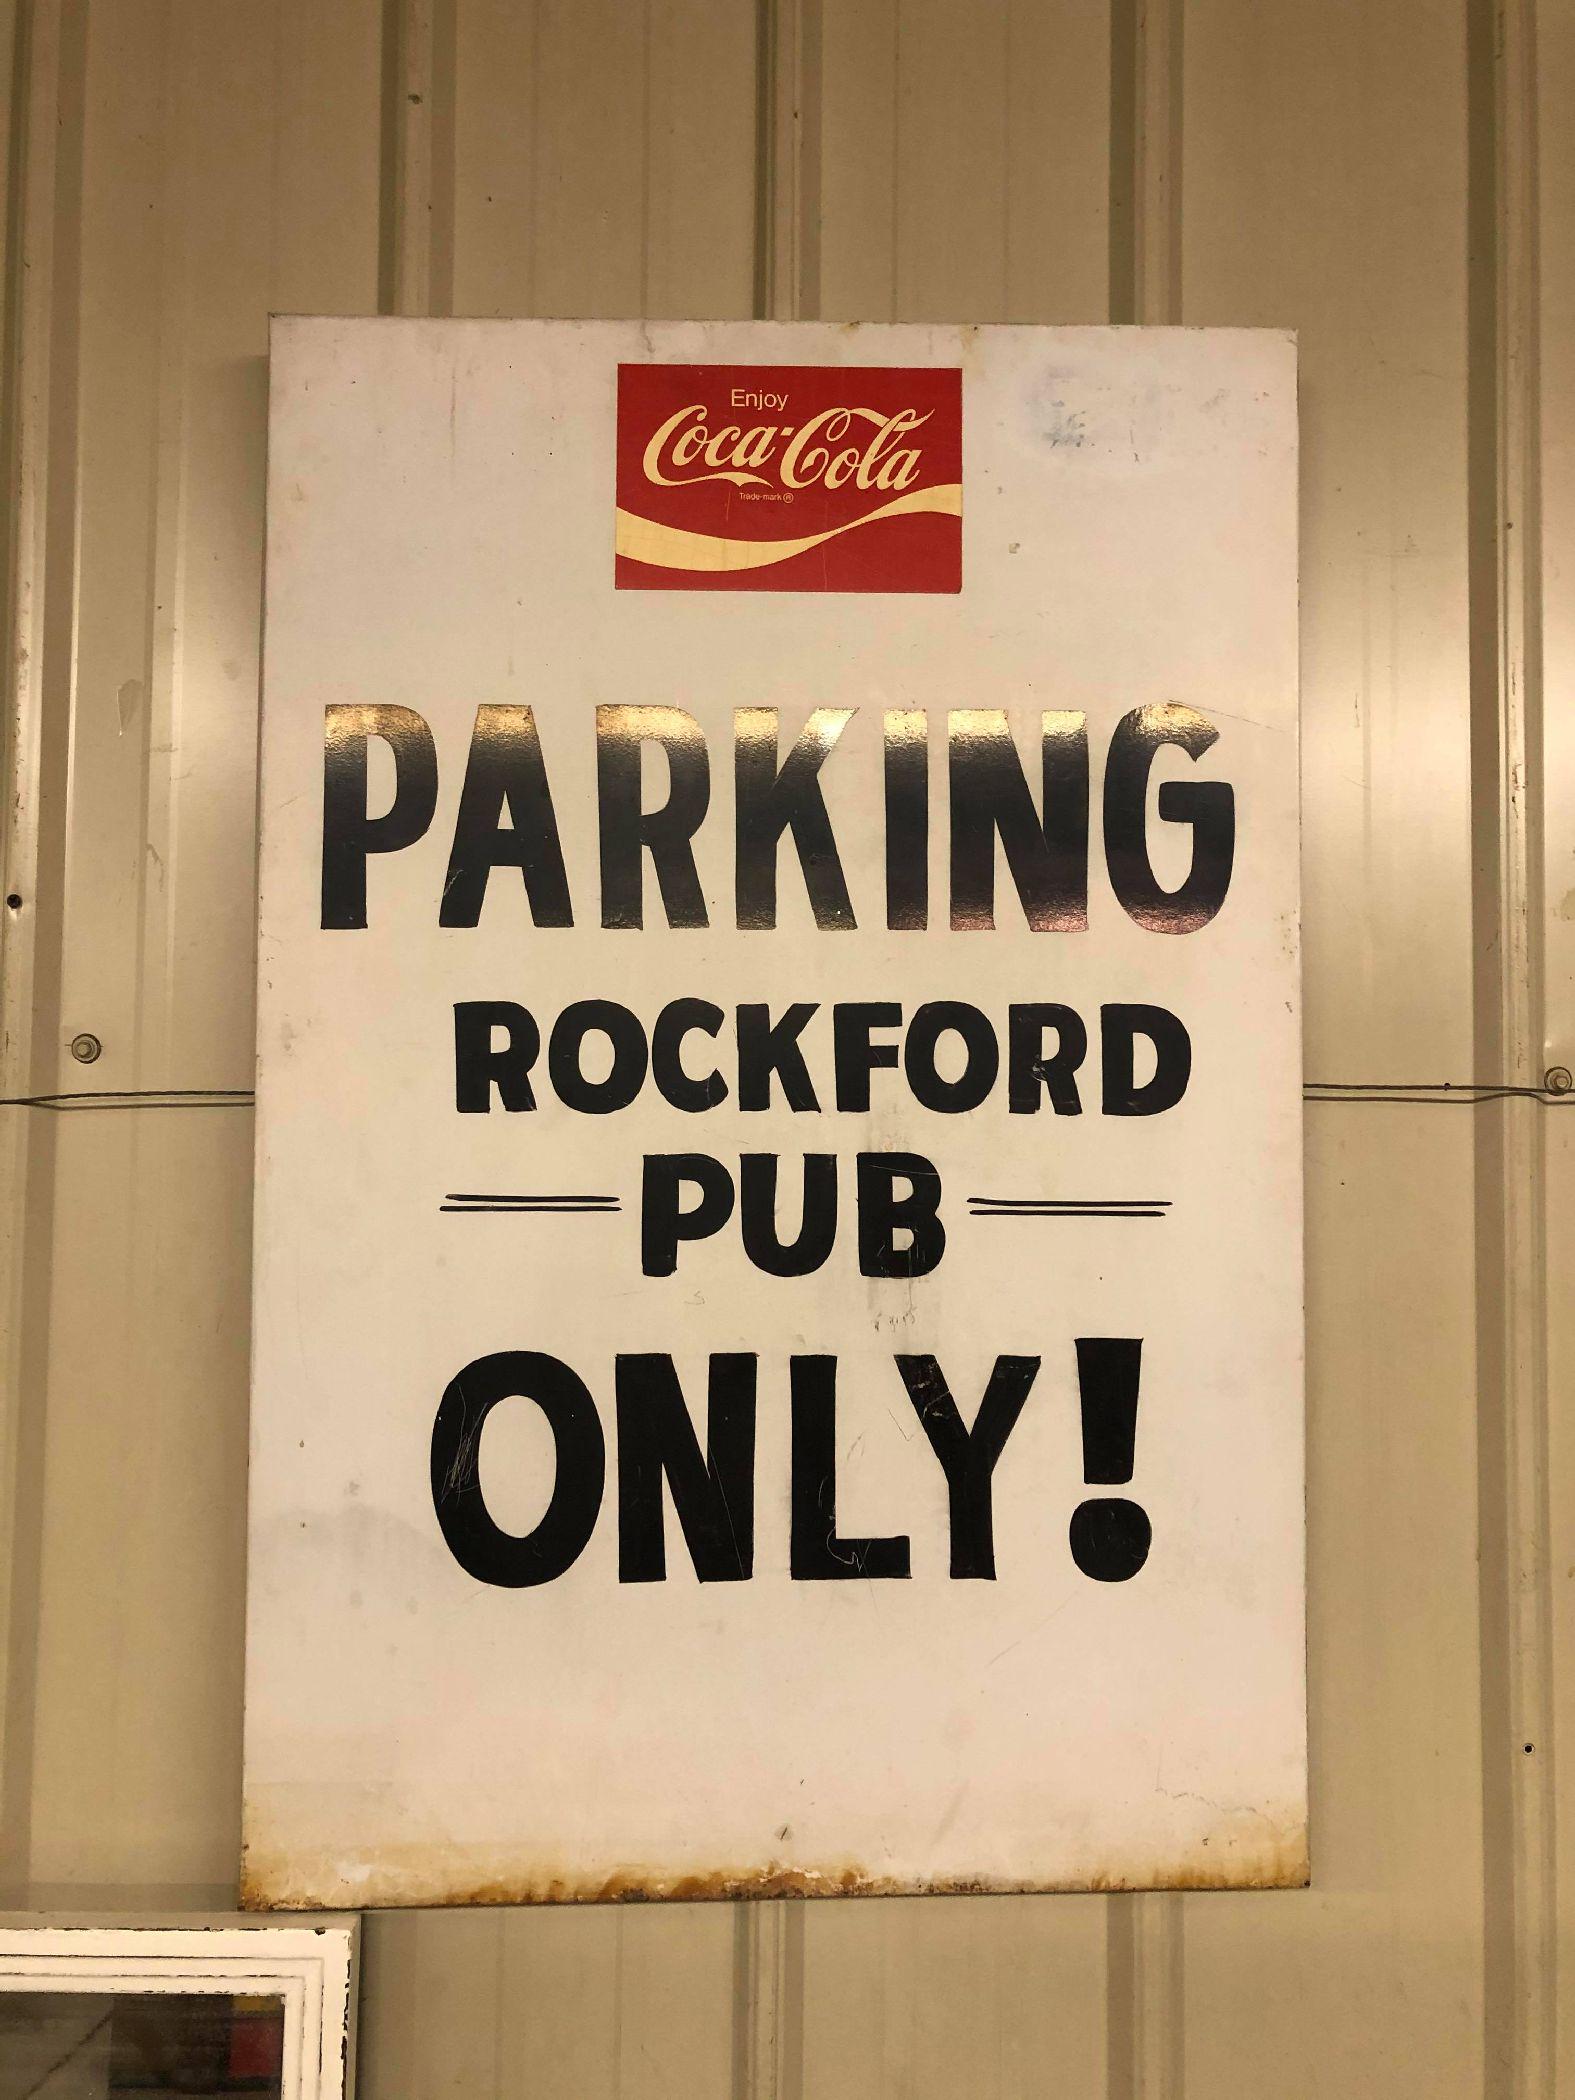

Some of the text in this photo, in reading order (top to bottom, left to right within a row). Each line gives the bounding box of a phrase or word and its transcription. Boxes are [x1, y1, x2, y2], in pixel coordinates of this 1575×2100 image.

[643, 404, 936, 490] Coca-Cola
[731, 389, 789, 411] Enjoy
[321, 702, 1236, 935] PARKING
[453, 998, 1192, 1116] ROCKFORD
[641, 1151, 946, 1279] PUB
[430, 1337, 1152, 1588] ONLY!
